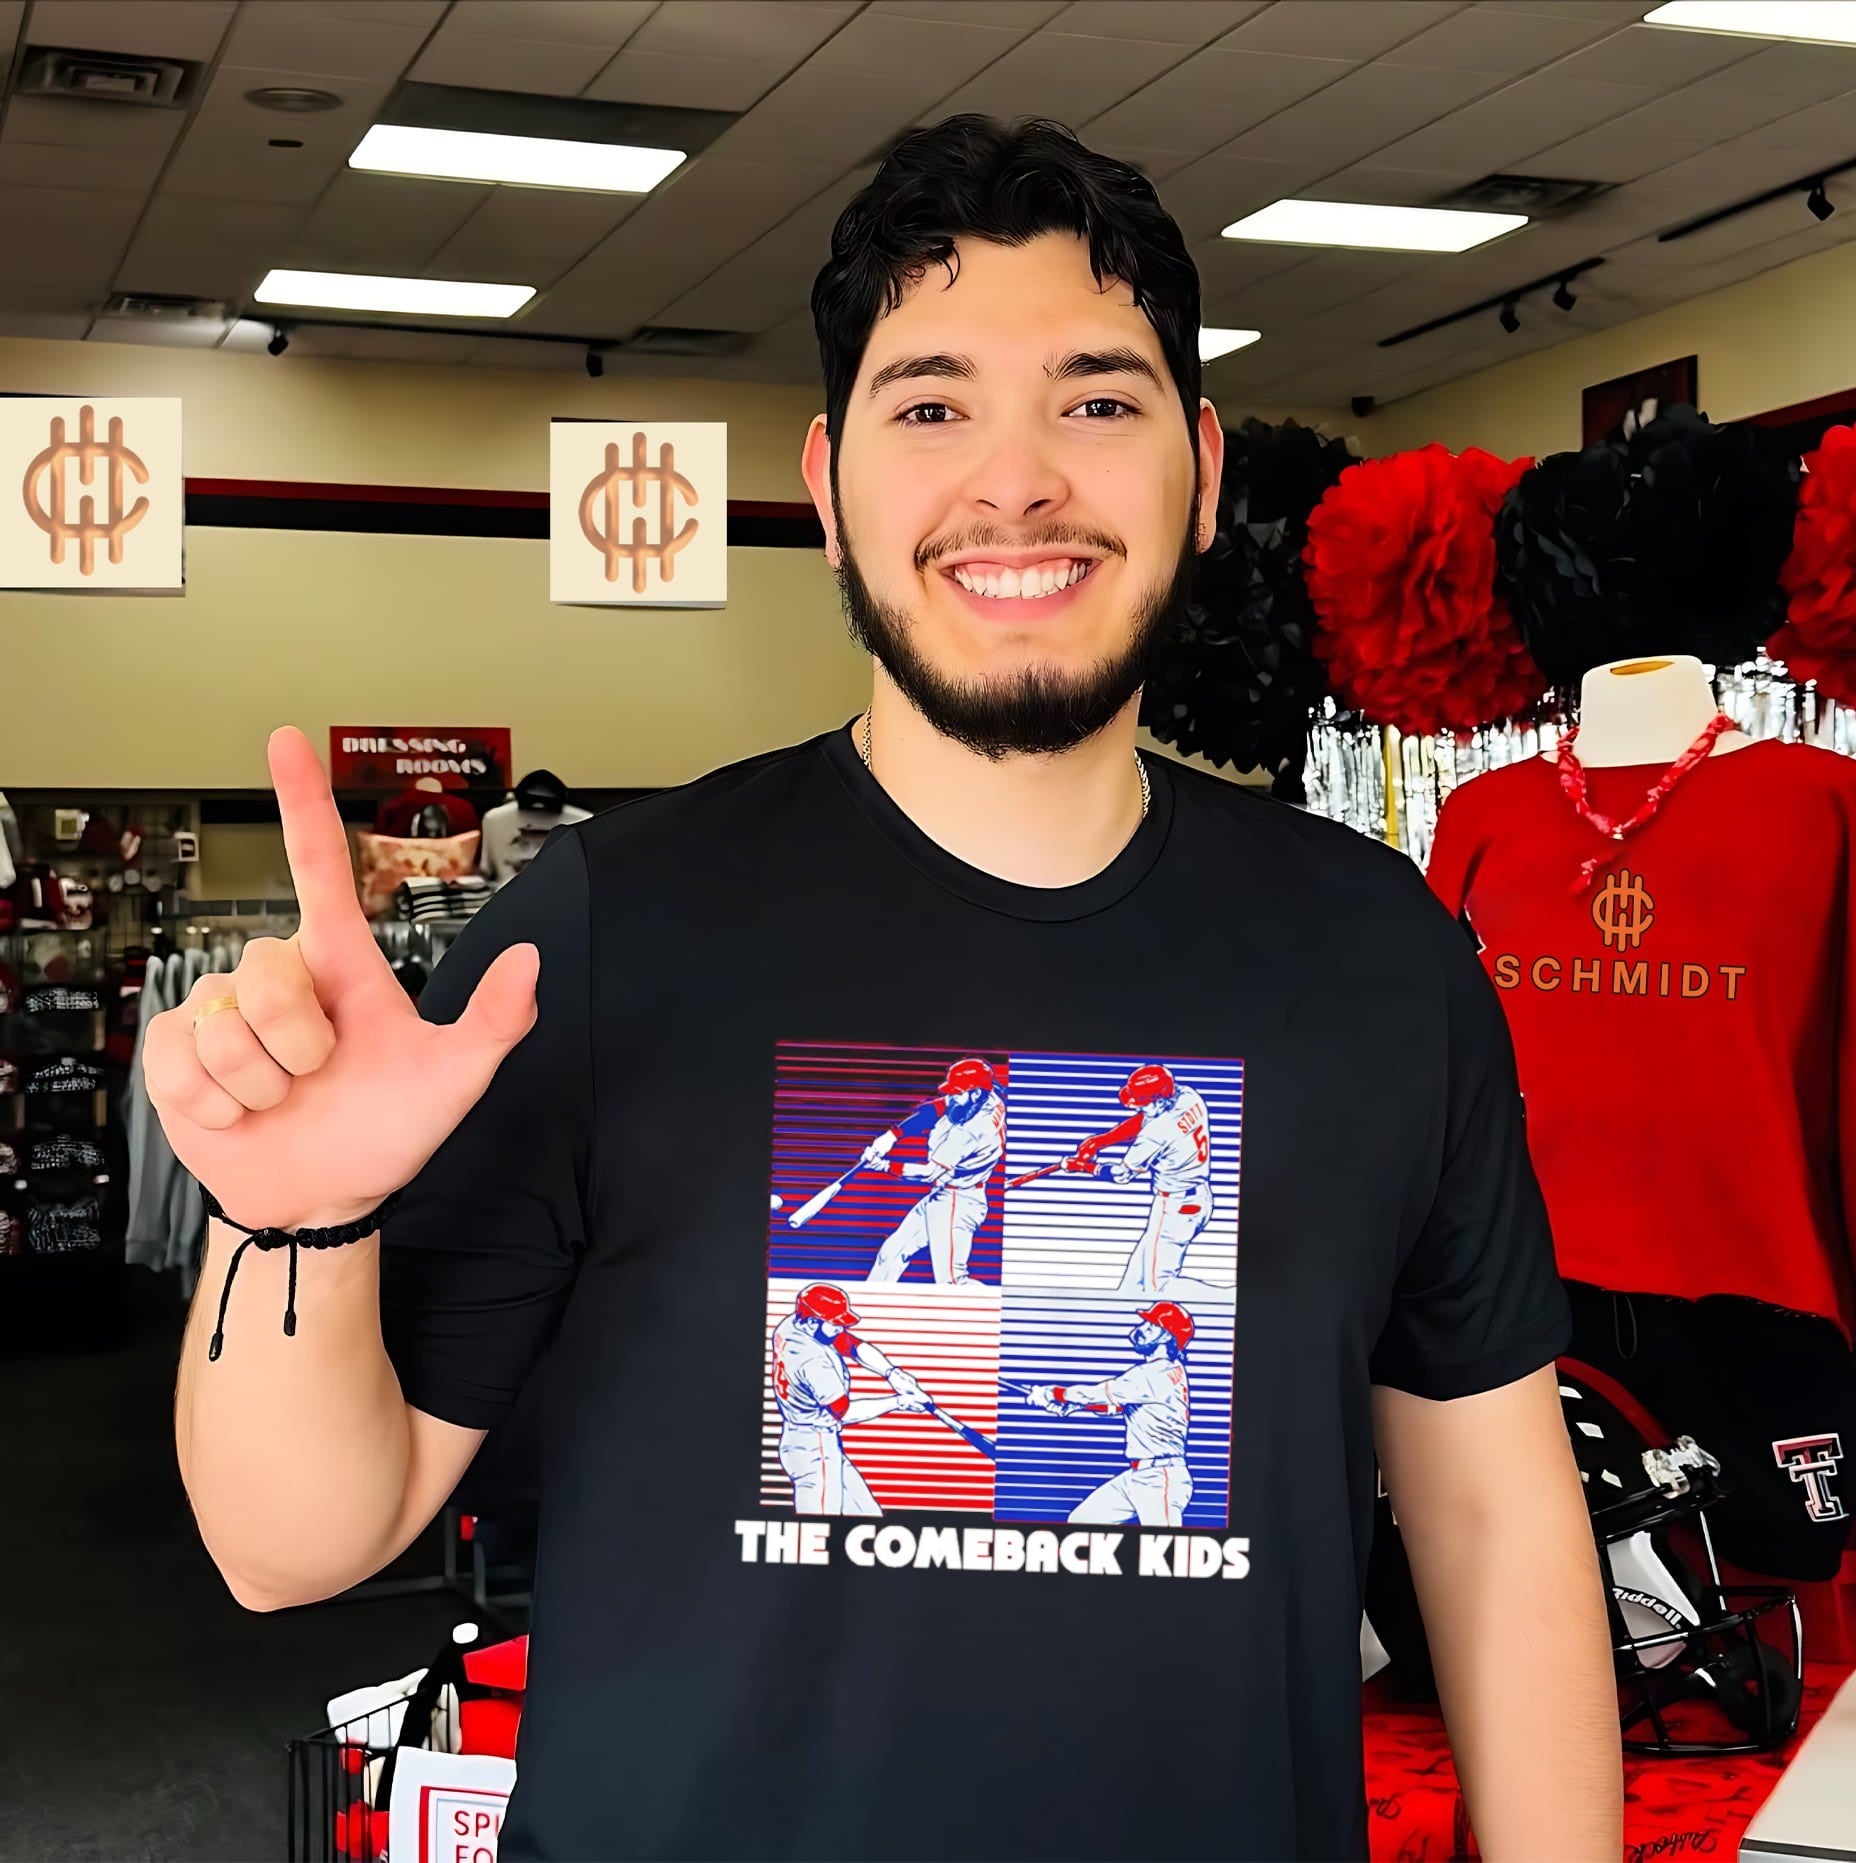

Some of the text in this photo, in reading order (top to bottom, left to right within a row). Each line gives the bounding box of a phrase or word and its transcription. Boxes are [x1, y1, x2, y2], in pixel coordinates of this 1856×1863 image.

[396, 758, 487, 775] ROOMS
[1494, 954, 1747, 1000] SCHMIDT
[1193, 1124, 1208, 1162] 5
[734, 1519, 1251, 1580] THE COMEBACK KIDS
